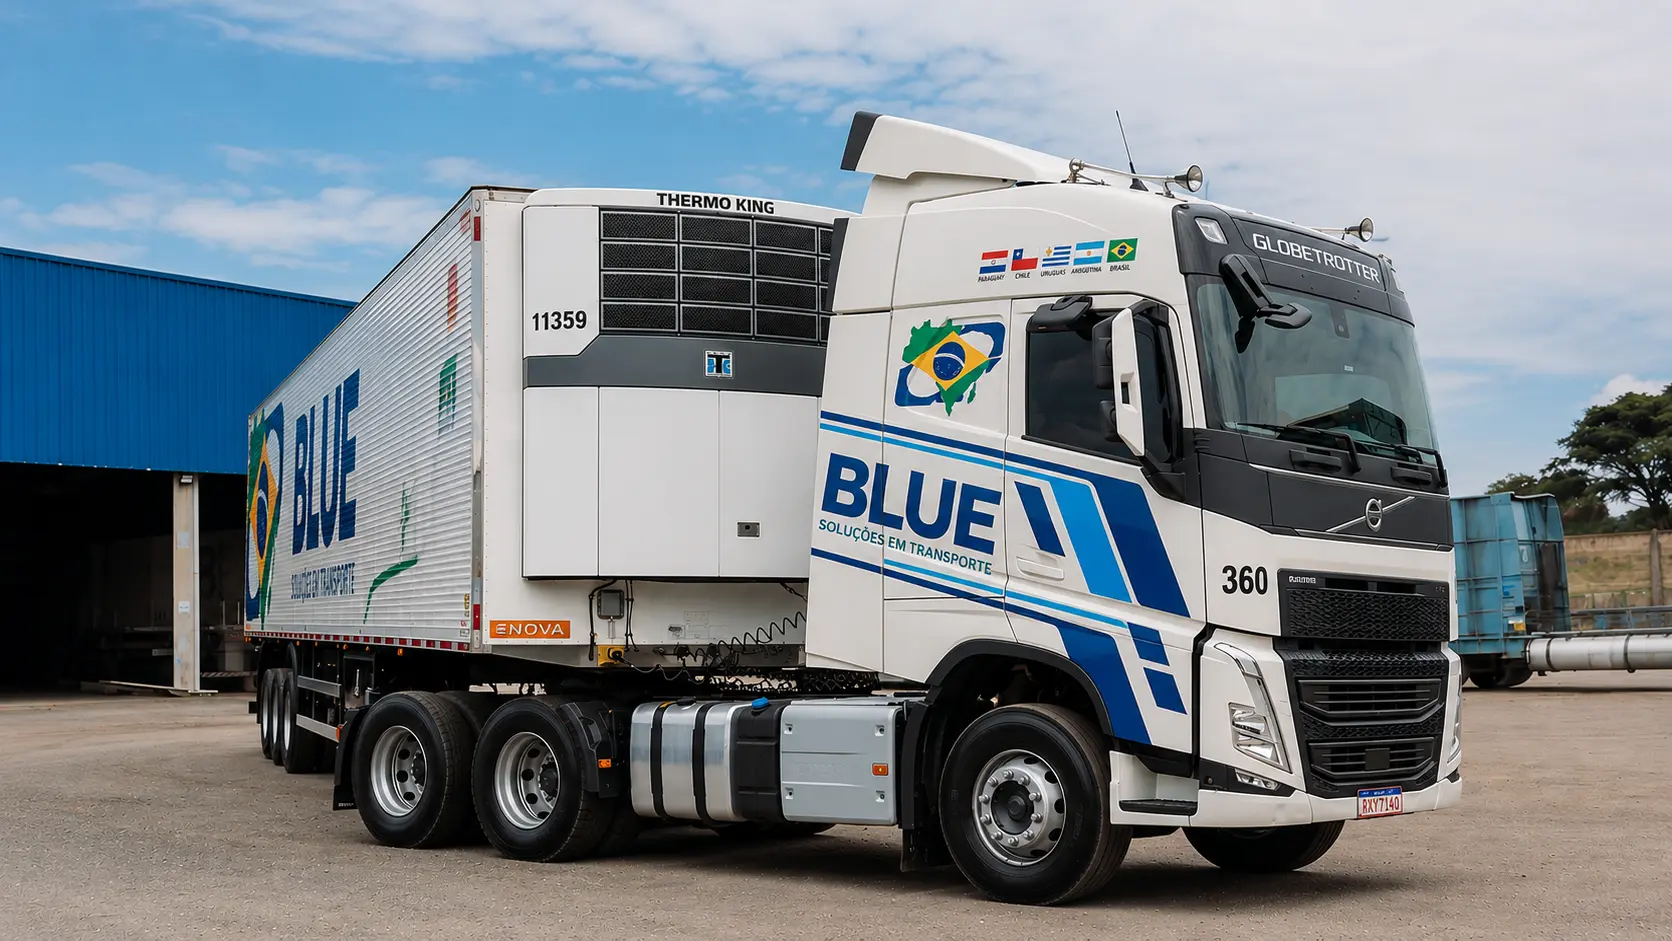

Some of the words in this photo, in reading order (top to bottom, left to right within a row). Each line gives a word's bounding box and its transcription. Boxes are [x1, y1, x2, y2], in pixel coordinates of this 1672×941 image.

[656, 192, 731, 210] THERMO
[735, 198, 774, 214] KING
[1252, 233, 1380, 284] GLOBETROTTER
[1015, 272, 1030, 280] CHILE
[532, 310, 587, 332] 11359
[292, 369, 360, 555] BLUE
[821, 452, 1002, 556] BLUE
[819, 519, 885, 545] SOLUÇÕES
[888, 536, 906, 552] EM
[909, 541, 992, 576] TRANSPORTE
[1222, 565, 1268, 594] 360
[495, 624, 565, 636] ENOVA
[1362, 796, 1400, 813] RXY7140
